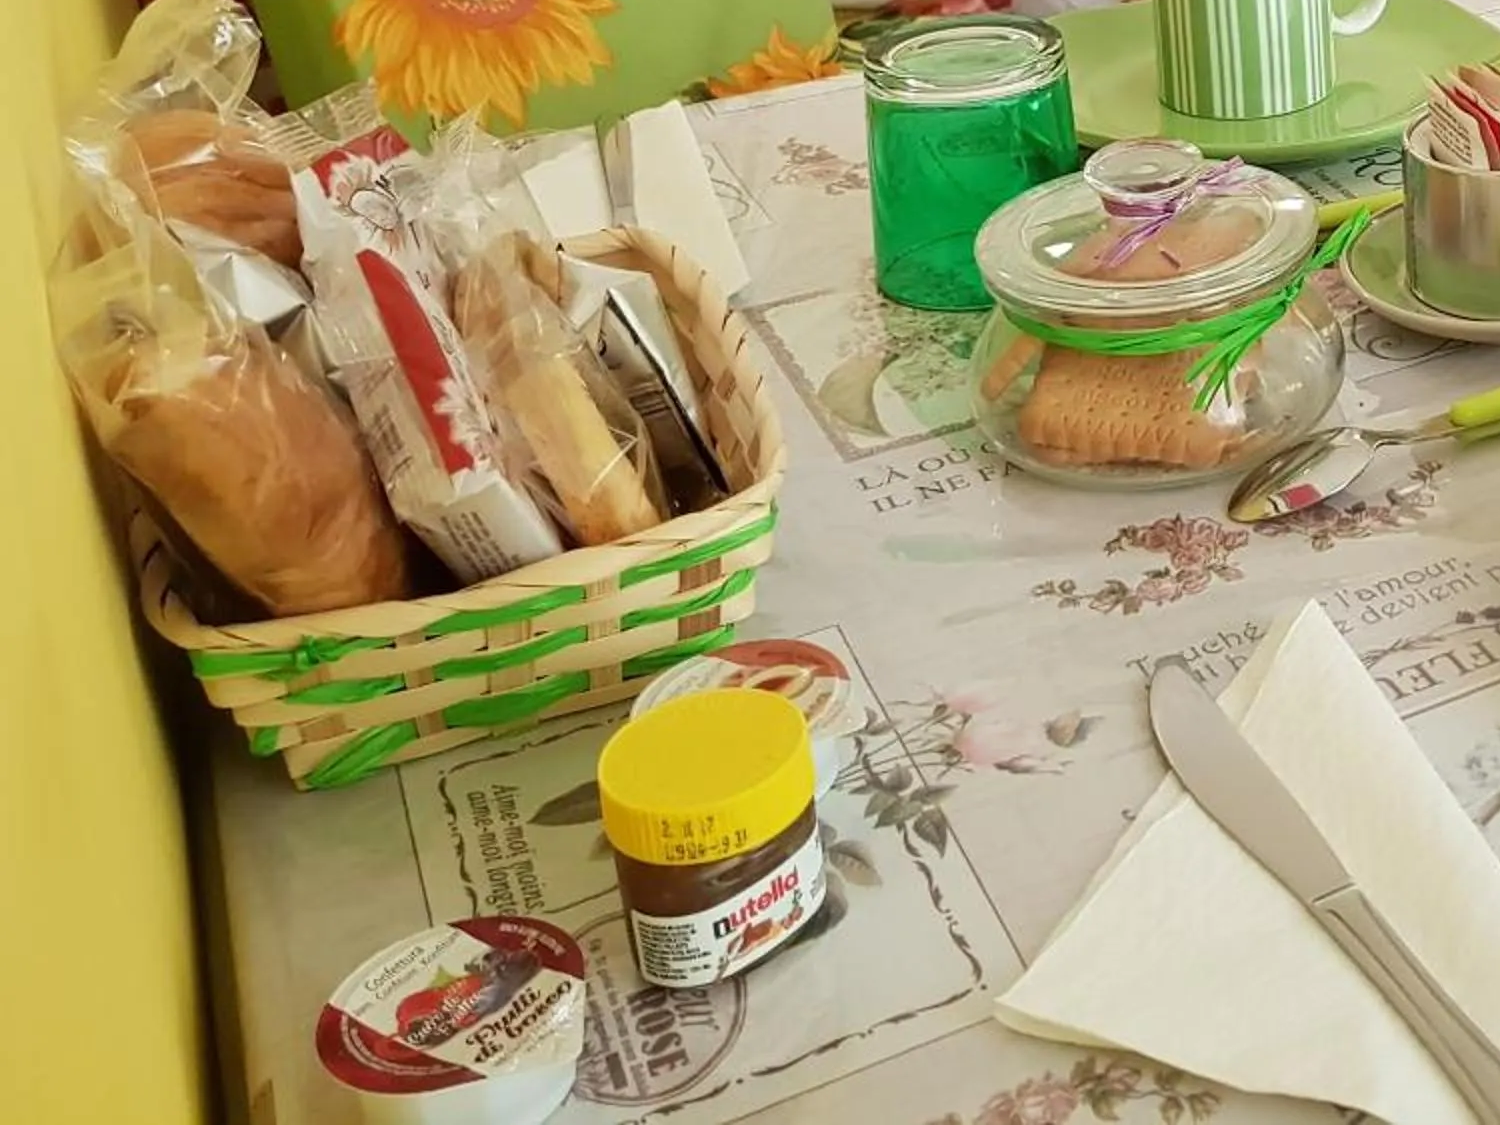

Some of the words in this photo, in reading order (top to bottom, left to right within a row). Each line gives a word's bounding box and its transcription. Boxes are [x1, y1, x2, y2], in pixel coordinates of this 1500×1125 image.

[855, 463, 910, 492] LÀ
[915, 444, 971, 472] OÙ
[870, 497, 915, 514] IL
[919, 475, 974, 501] NE
[1353, 572, 1485, 632] devient
[1125, 619, 1263, 676] Tuché
[468, 788, 503, 869] aime-moi
[490, 781, 531, 860] Aime-moi
[713, 865, 800, 940] nutella
[627, 989, 690, 1078] ROSE
